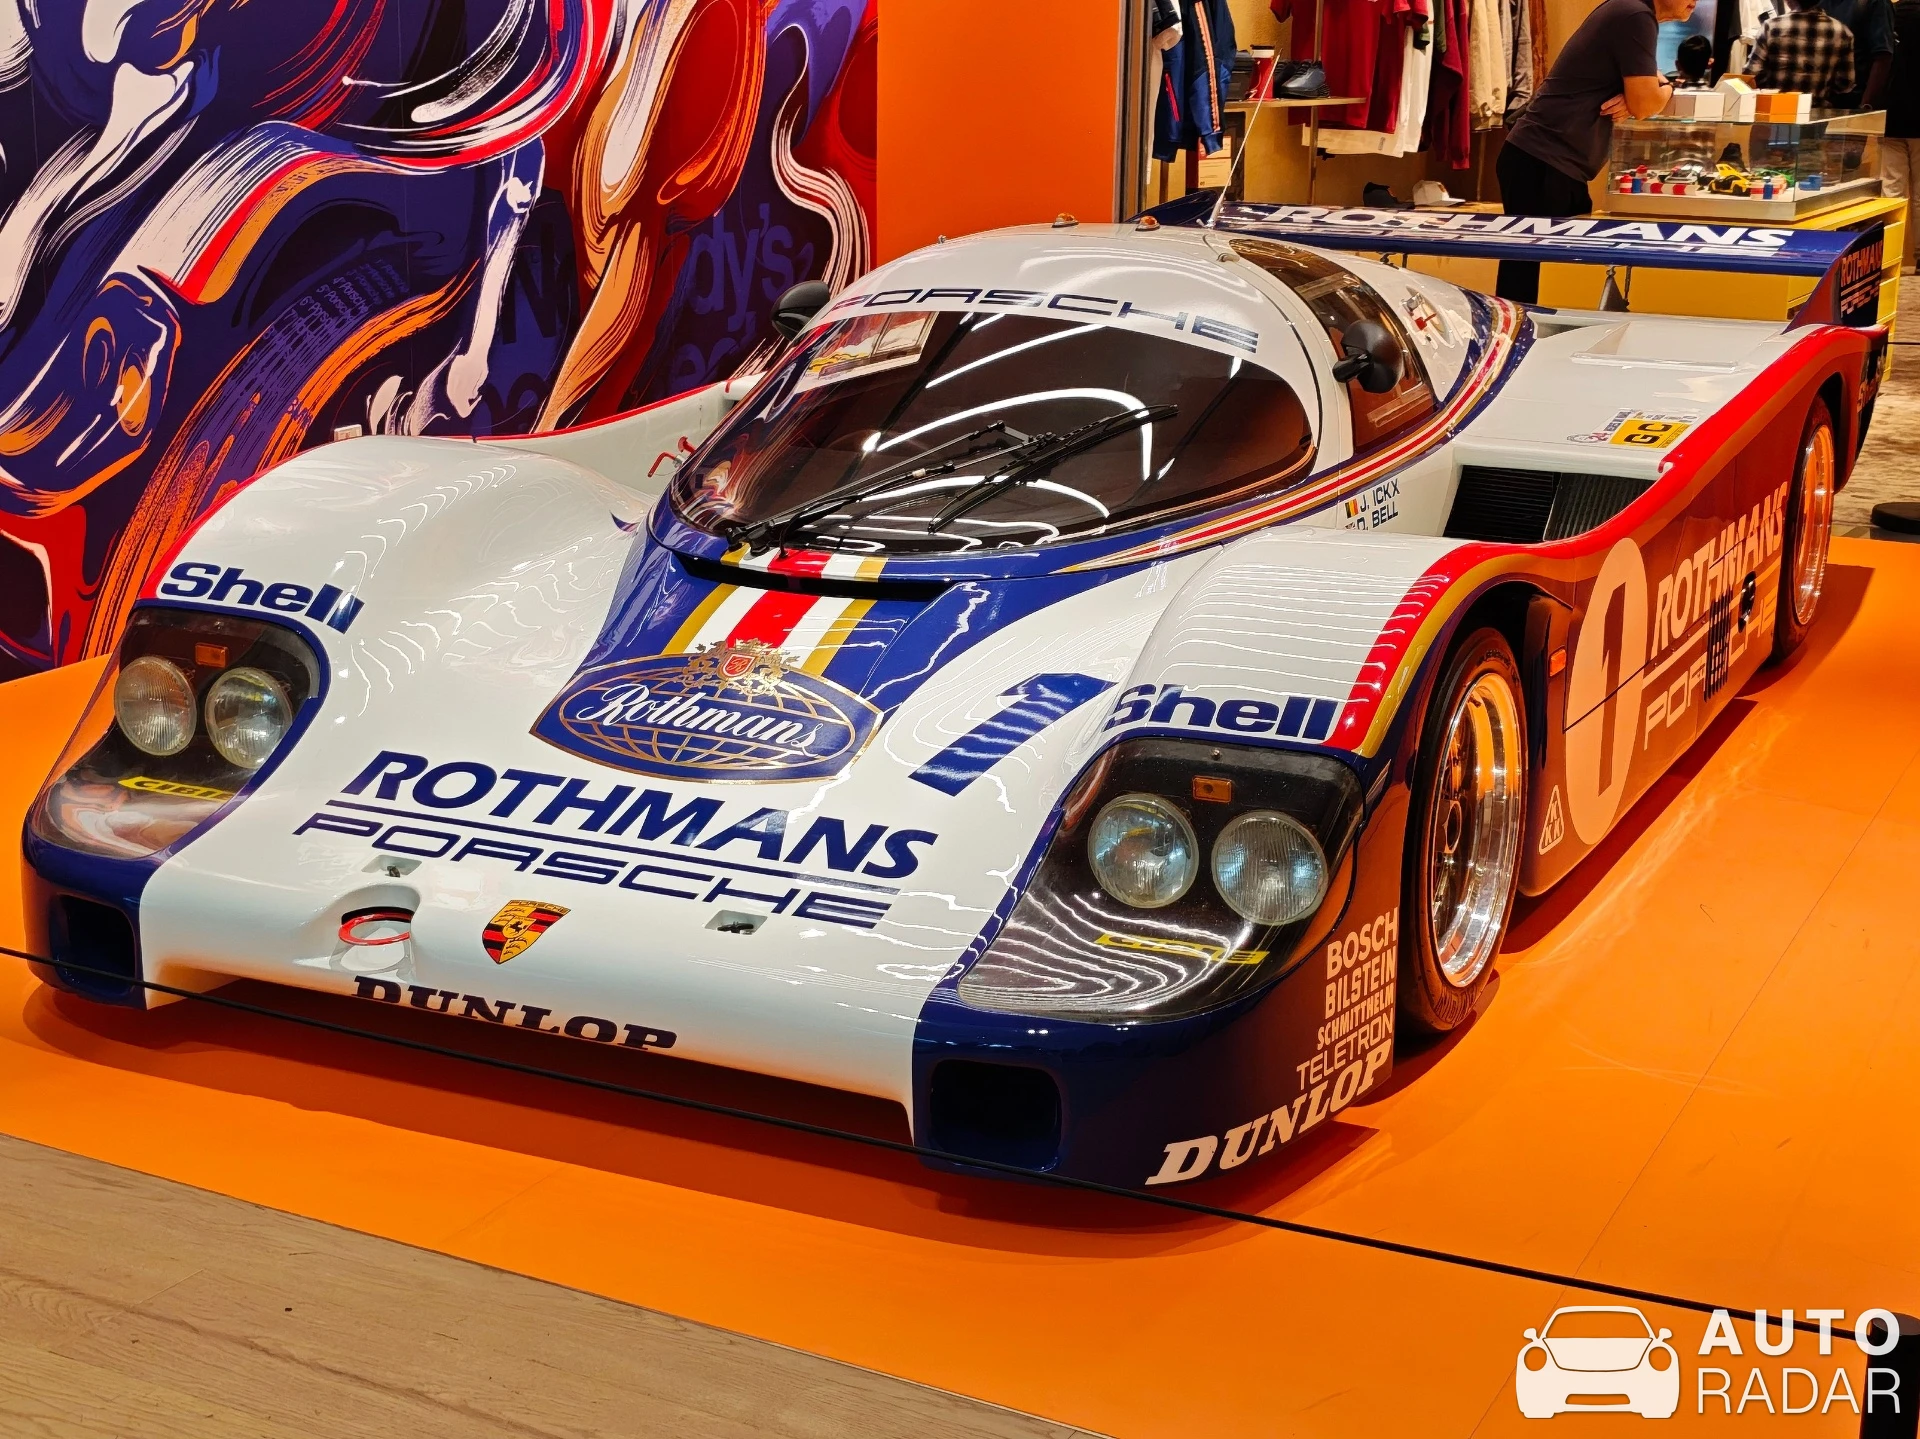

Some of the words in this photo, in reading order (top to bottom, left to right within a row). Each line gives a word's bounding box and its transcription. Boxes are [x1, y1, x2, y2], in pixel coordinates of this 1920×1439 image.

[1261, 205, 1795, 248] ROTHMANS
[820, 287, 1260, 354] PORSCHE
[1360, 494, 1370, 513] J.
[1372, 478, 1400, 507] ICKX
[1371, 501, 1399, 528] BELL
[161, 561, 366, 635] Shell
[1652, 482, 1789, 659] ROTHMANS
[577, 683, 824, 759] Rothmans
[909, 672, 1119, 797] 1
[1103, 684, 1338, 741] Shell
[341, 750, 939, 880] ROTHMANS
[292, 812, 894, 929] PORSCHE
[1327, 907, 1398, 980] BOSCH
[352, 976, 678, 1050] DUNLOP
[1317, 983, 1395, 1051] SCHMITTHELM
[1325, 946, 1397, 1020] BILSTEIN
[1297, 1008, 1394, 1092] TELETRON
[1145, 1039, 1392, 1186] DUNLOP
